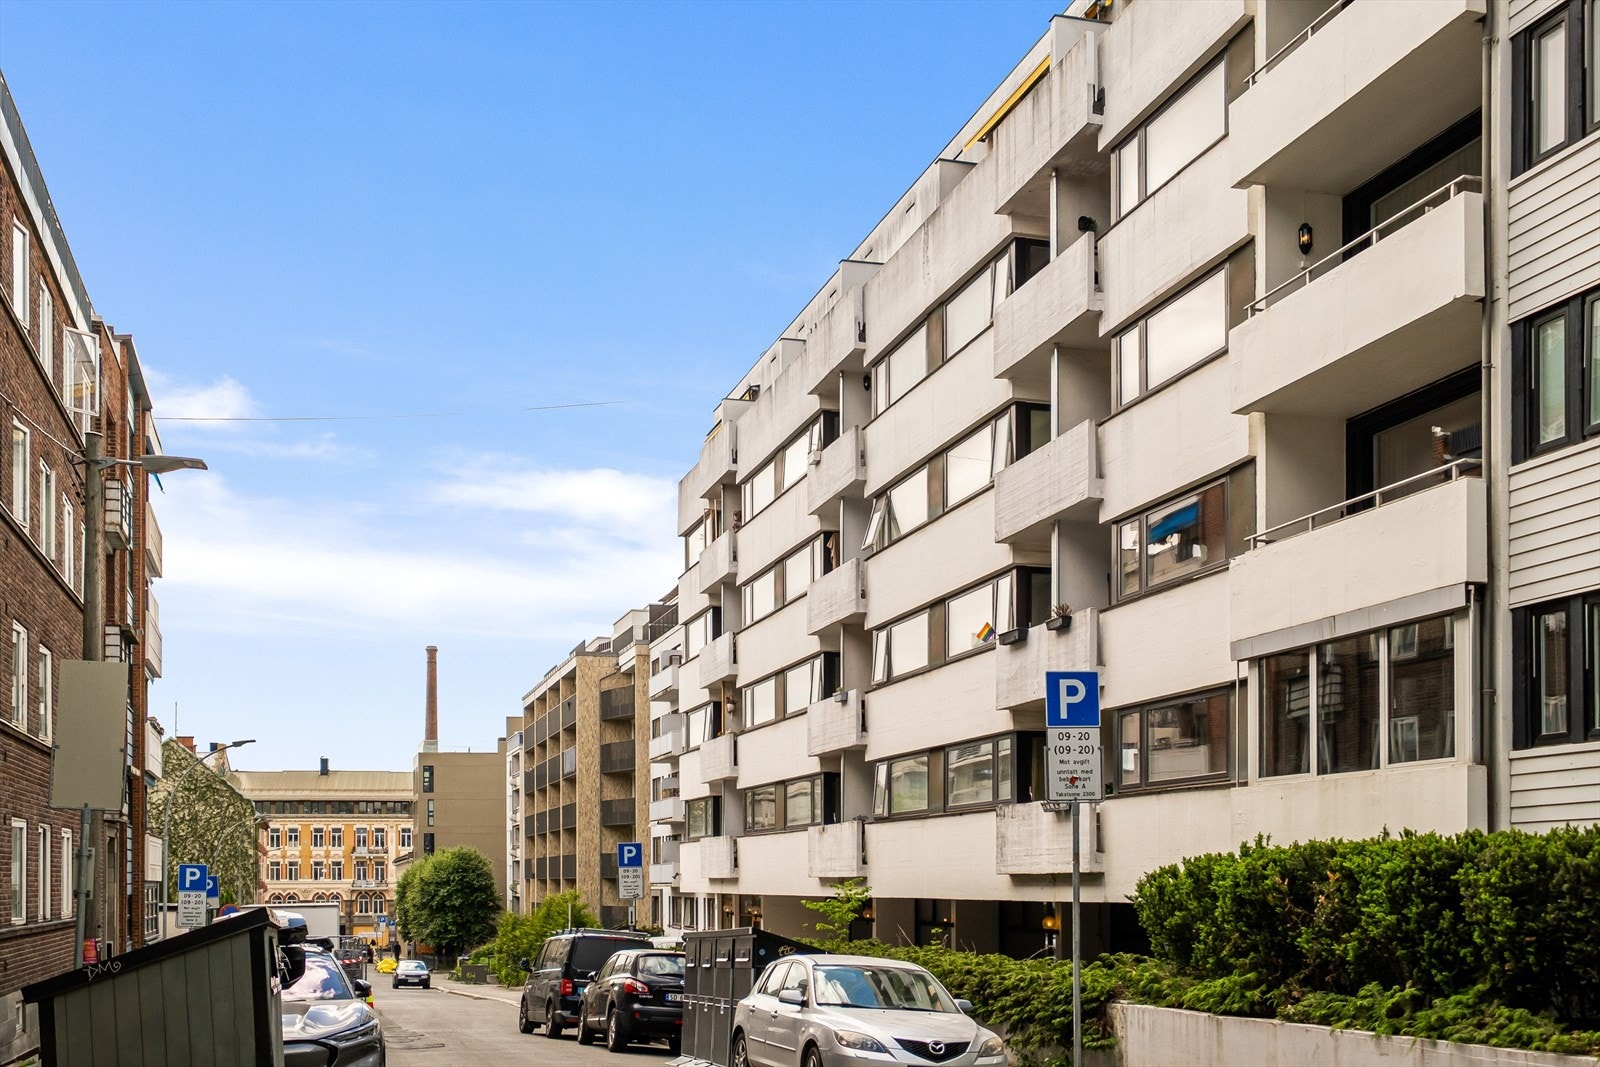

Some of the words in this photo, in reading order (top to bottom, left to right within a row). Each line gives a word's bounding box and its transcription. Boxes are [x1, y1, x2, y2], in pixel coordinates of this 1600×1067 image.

[1059, 678, 1086, 719] P
[624, 846, 637, 864] P
[185, 867, 200, 888] P
